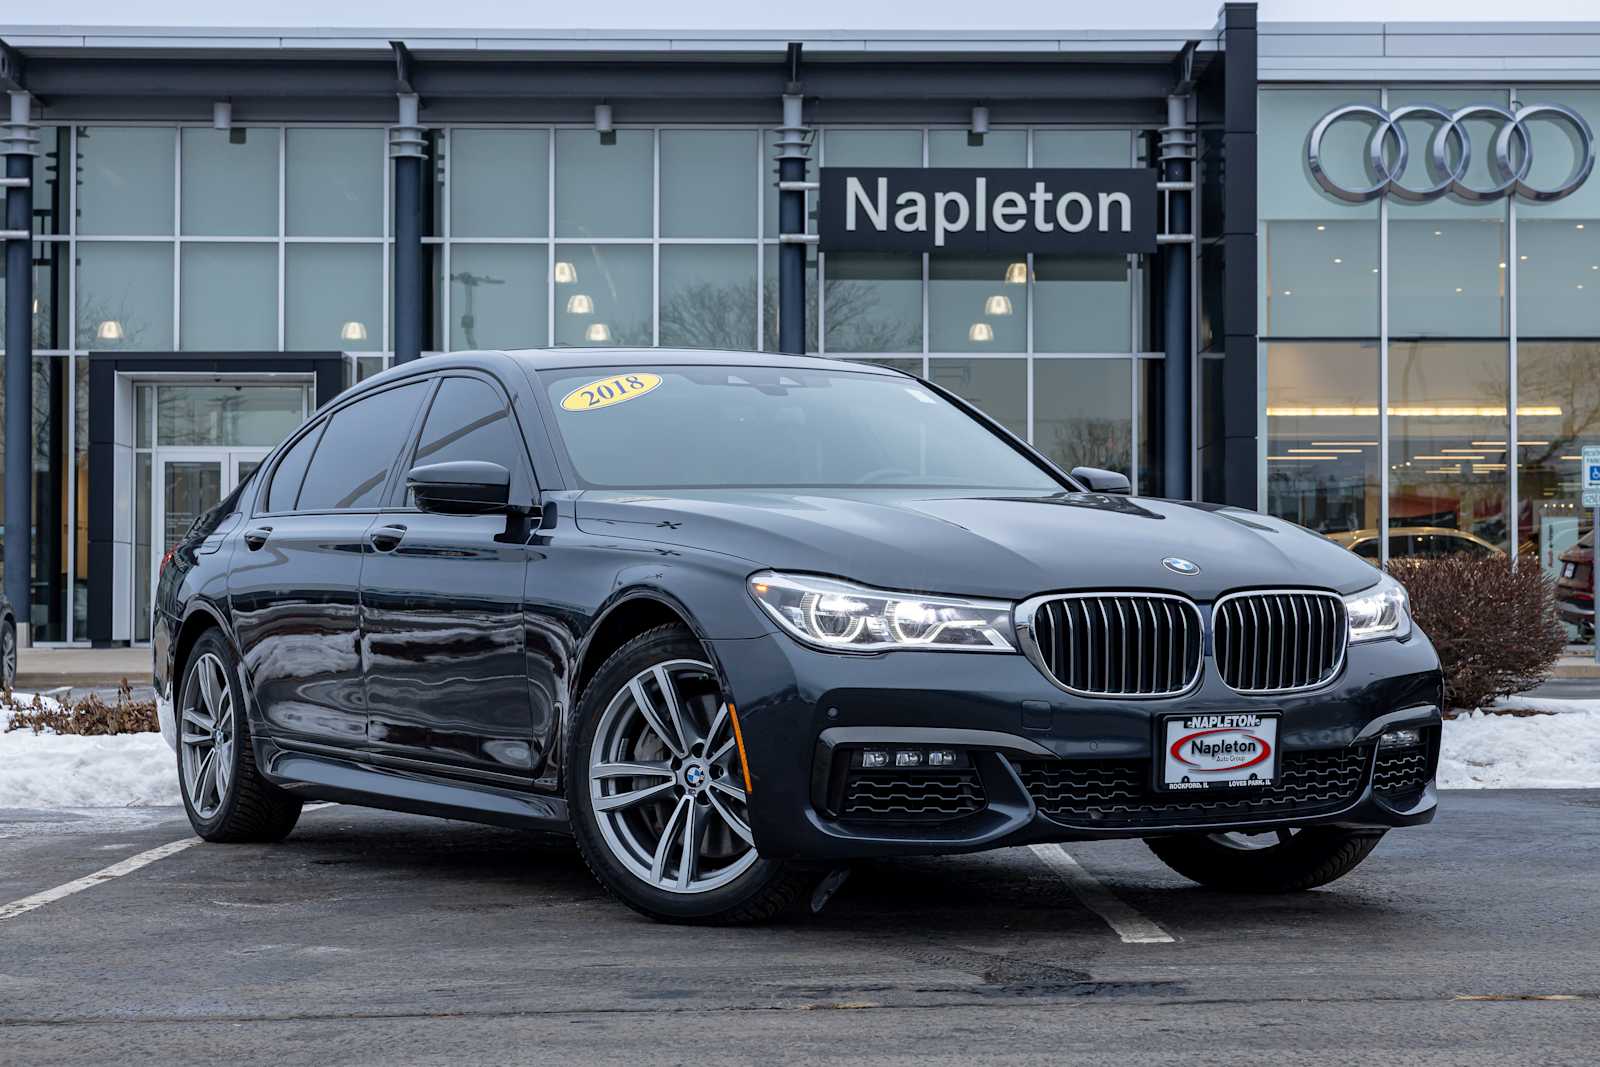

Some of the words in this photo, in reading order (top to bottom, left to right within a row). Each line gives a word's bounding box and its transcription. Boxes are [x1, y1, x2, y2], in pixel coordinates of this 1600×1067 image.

[846, 177, 1131, 246] Napleton
[580, 376, 644, 406] 2018
[1192, 715, 1256, 728] NAPLETON
[1191, 739, 1256, 757] Napleton
